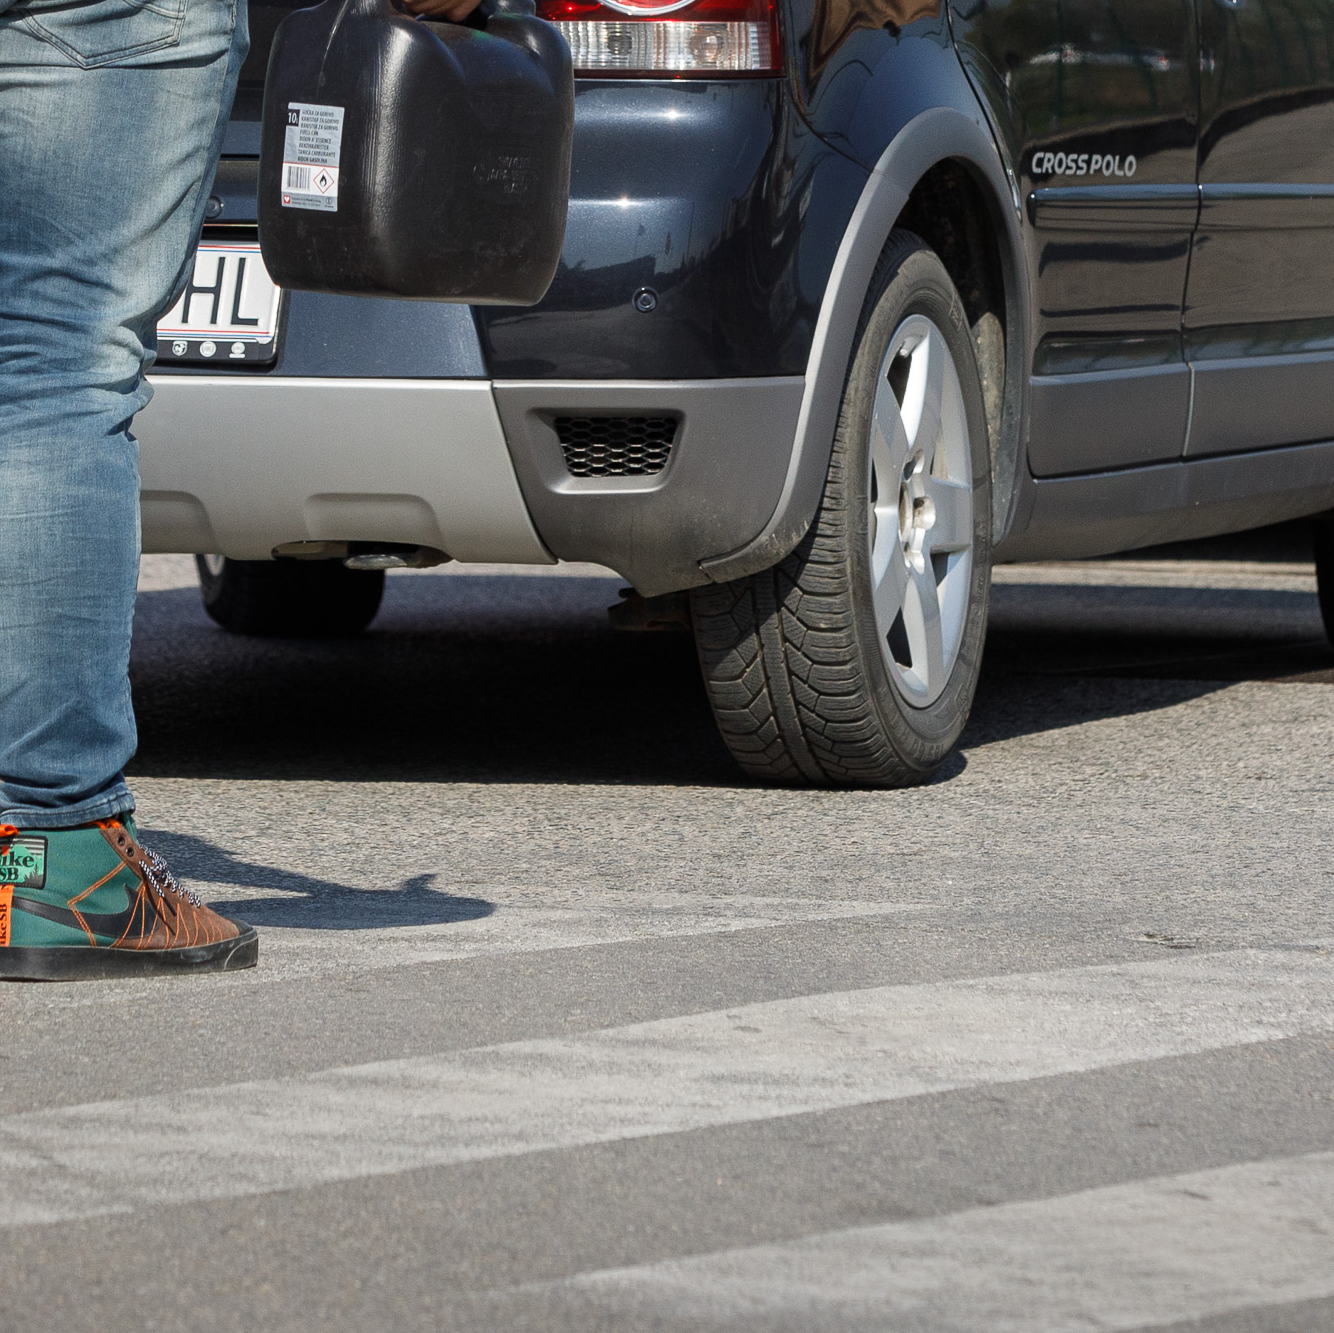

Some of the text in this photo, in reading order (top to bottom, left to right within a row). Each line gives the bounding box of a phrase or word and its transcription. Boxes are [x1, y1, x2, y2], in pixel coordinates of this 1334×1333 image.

[1031, 151, 1137, 177] CROSS POLO
[182, 257, 260, 326] HL
